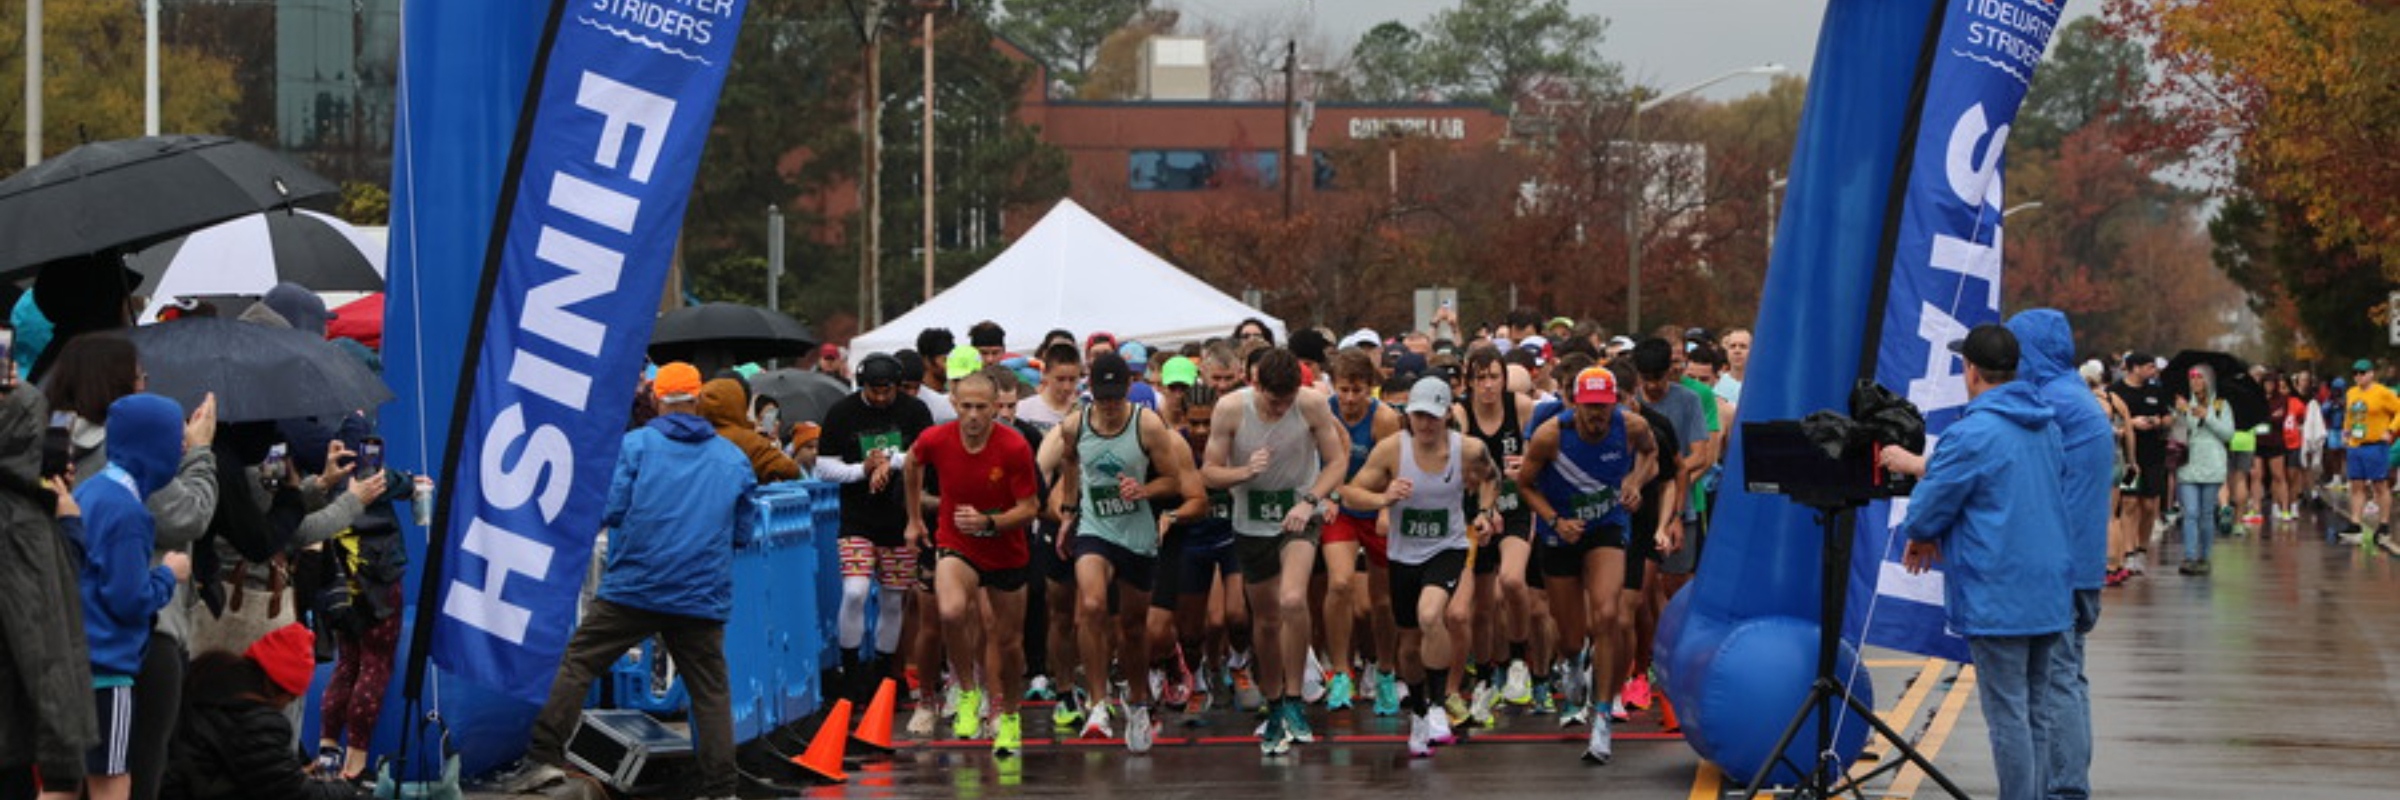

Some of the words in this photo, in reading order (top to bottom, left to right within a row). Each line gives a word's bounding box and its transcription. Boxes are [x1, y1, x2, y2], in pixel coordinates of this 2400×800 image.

[1967, 21, 2042, 67] STRIDER
[442, 70, 678, 646] FINISH
[1874, 101, 2010, 637] STAT
[1261, 503, 1283, 519] 54
[1407, 521, 1441, 537] 769
